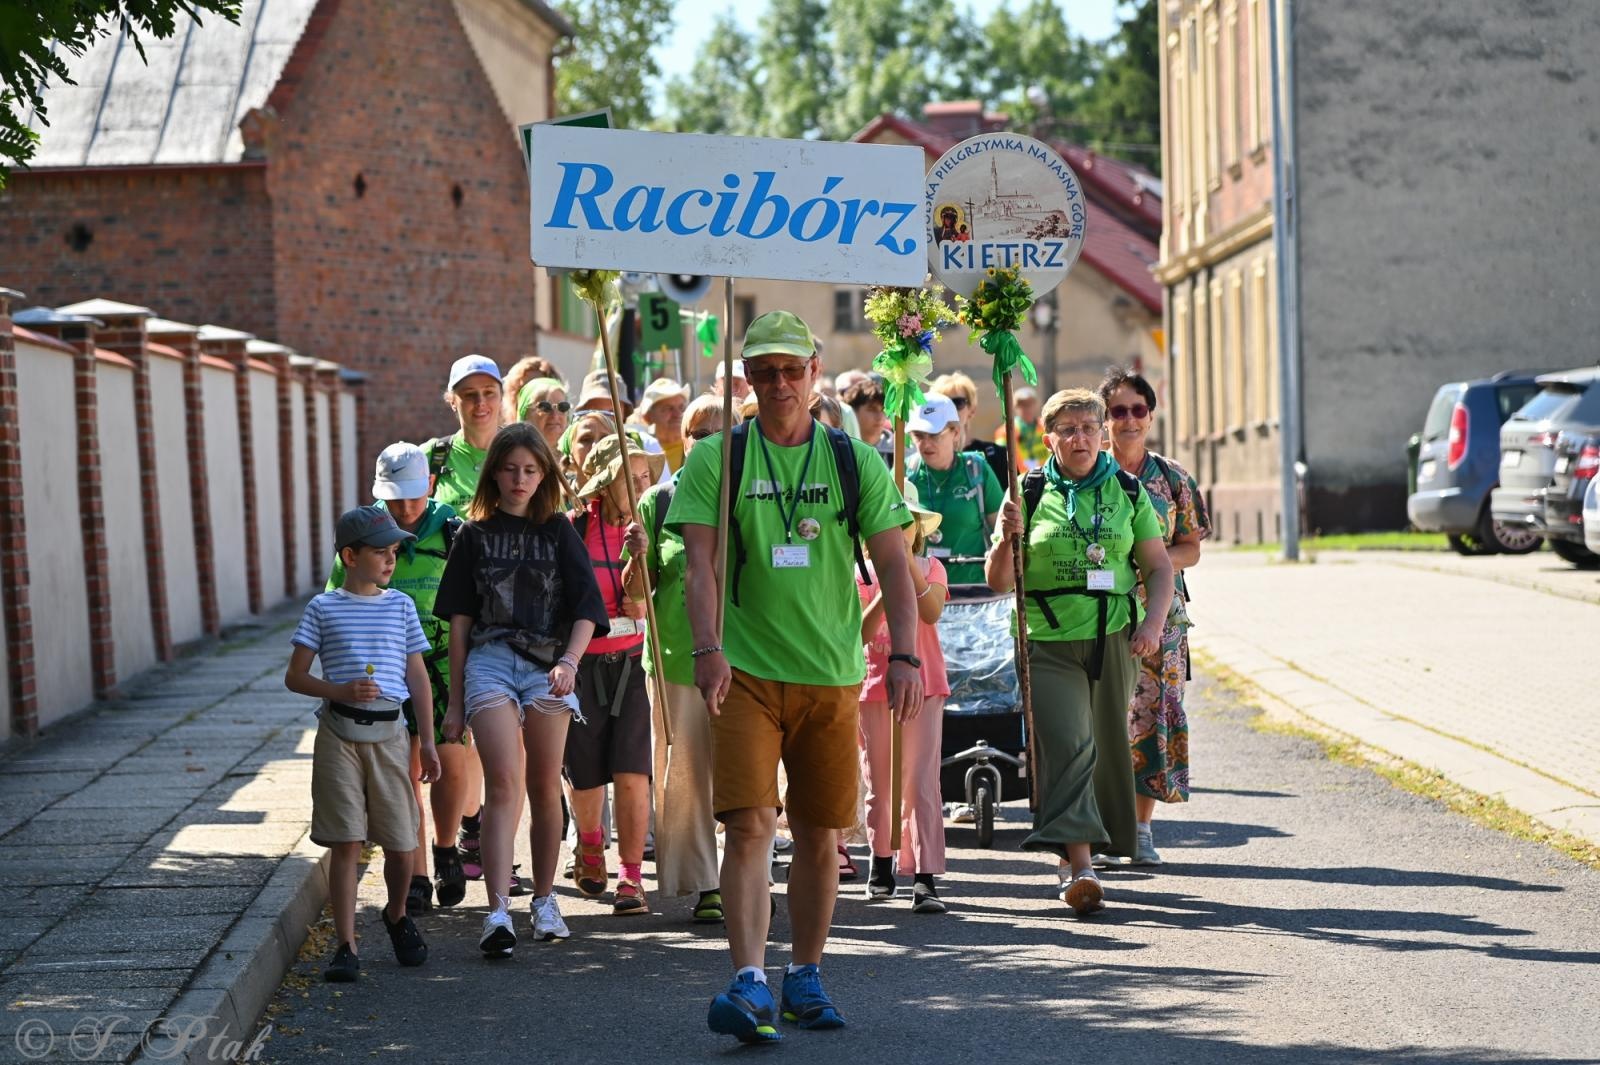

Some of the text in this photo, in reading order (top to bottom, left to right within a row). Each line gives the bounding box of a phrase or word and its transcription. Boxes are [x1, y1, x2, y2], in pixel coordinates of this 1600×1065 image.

[935, 138, 1024, 181] PIELGRZYMKA
[1027, 144, 1047, 163] NA
[543, 161, 918, 256] Racibórz
[943, 241, 1064, 270] KIETRZ
[650, 297, 670, 331] 5
[480, 532, 557, 560] NIRVAN
